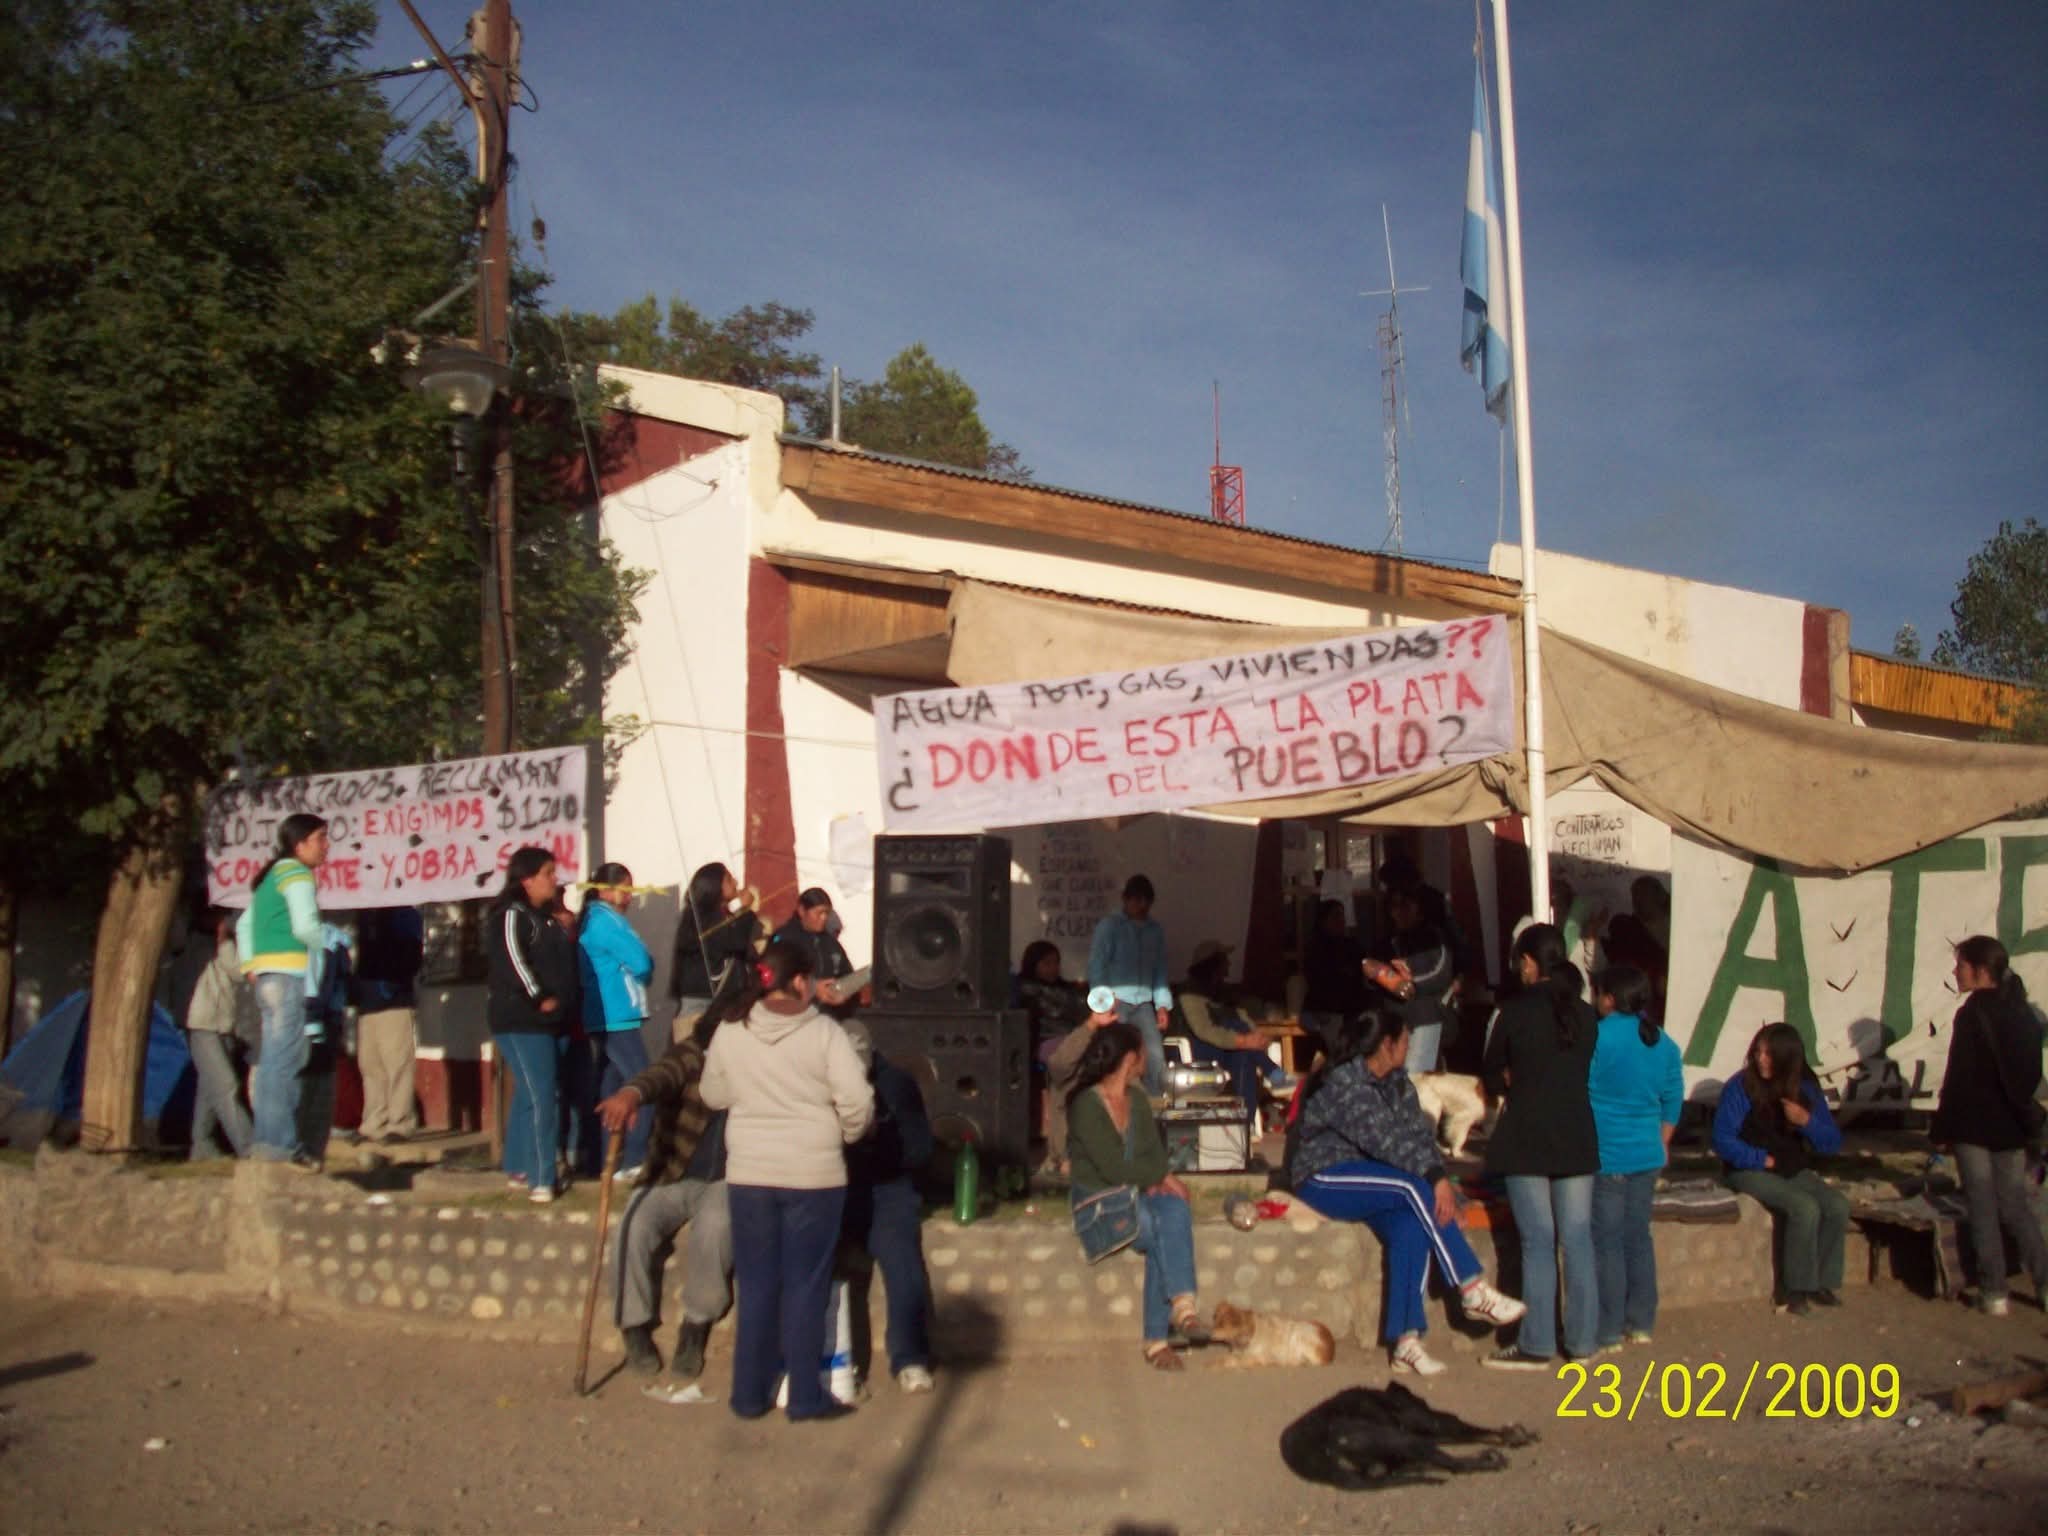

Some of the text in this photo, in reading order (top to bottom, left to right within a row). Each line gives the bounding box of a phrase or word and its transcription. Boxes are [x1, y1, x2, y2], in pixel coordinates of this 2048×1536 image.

[893, 690, 997, 733] AGUA
[1125, 705, 1241, 758] ESTA
[1269, 696, 1324, 733] LA
[1347, 671, 1485, 719] PLATA
[1108, 714, 1467, 798] DEL PUEBLO?
[405, 845, 480, 881] OBRA
